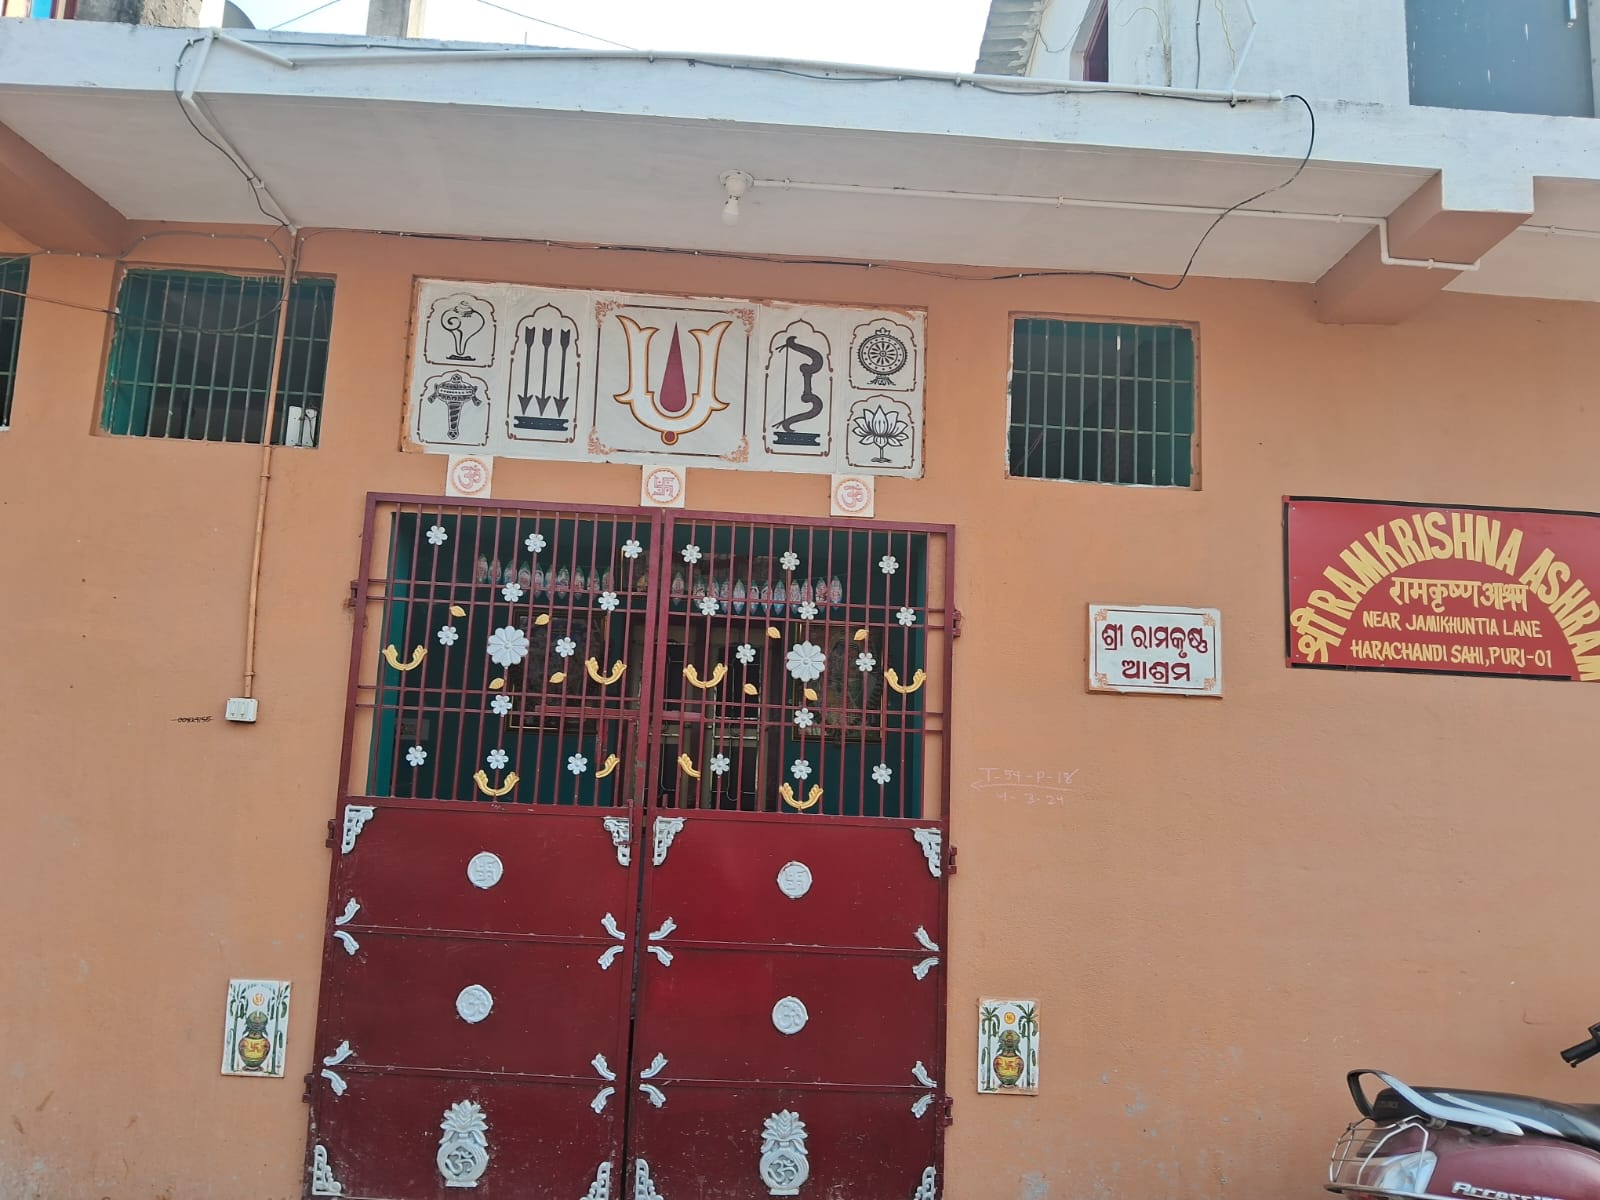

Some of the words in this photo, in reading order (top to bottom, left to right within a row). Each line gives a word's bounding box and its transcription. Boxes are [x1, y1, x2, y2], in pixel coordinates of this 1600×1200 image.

[1309, 512, 1524, 620] RAMKRISHNA
[1389, 577, 1482, 613] रामकृष्ण
[1480, 582, 1529, 613] आश्रम
[1362, 610, 1402, 631] NEAR
[1405, 614, 1500, 636] JAMIKHUNTIA
[1503, 619, 1543, 638] LANE
[1101, 623, 1123, 651] ଶ୍ରୀ
[1130, 625, 1209, 659] ରାମକୃଷ୍ଣ
[1350, 639, 1447, 662] HARACHANDI
[1121, 660, 1191, 685] ଆଶ୍ରମ
